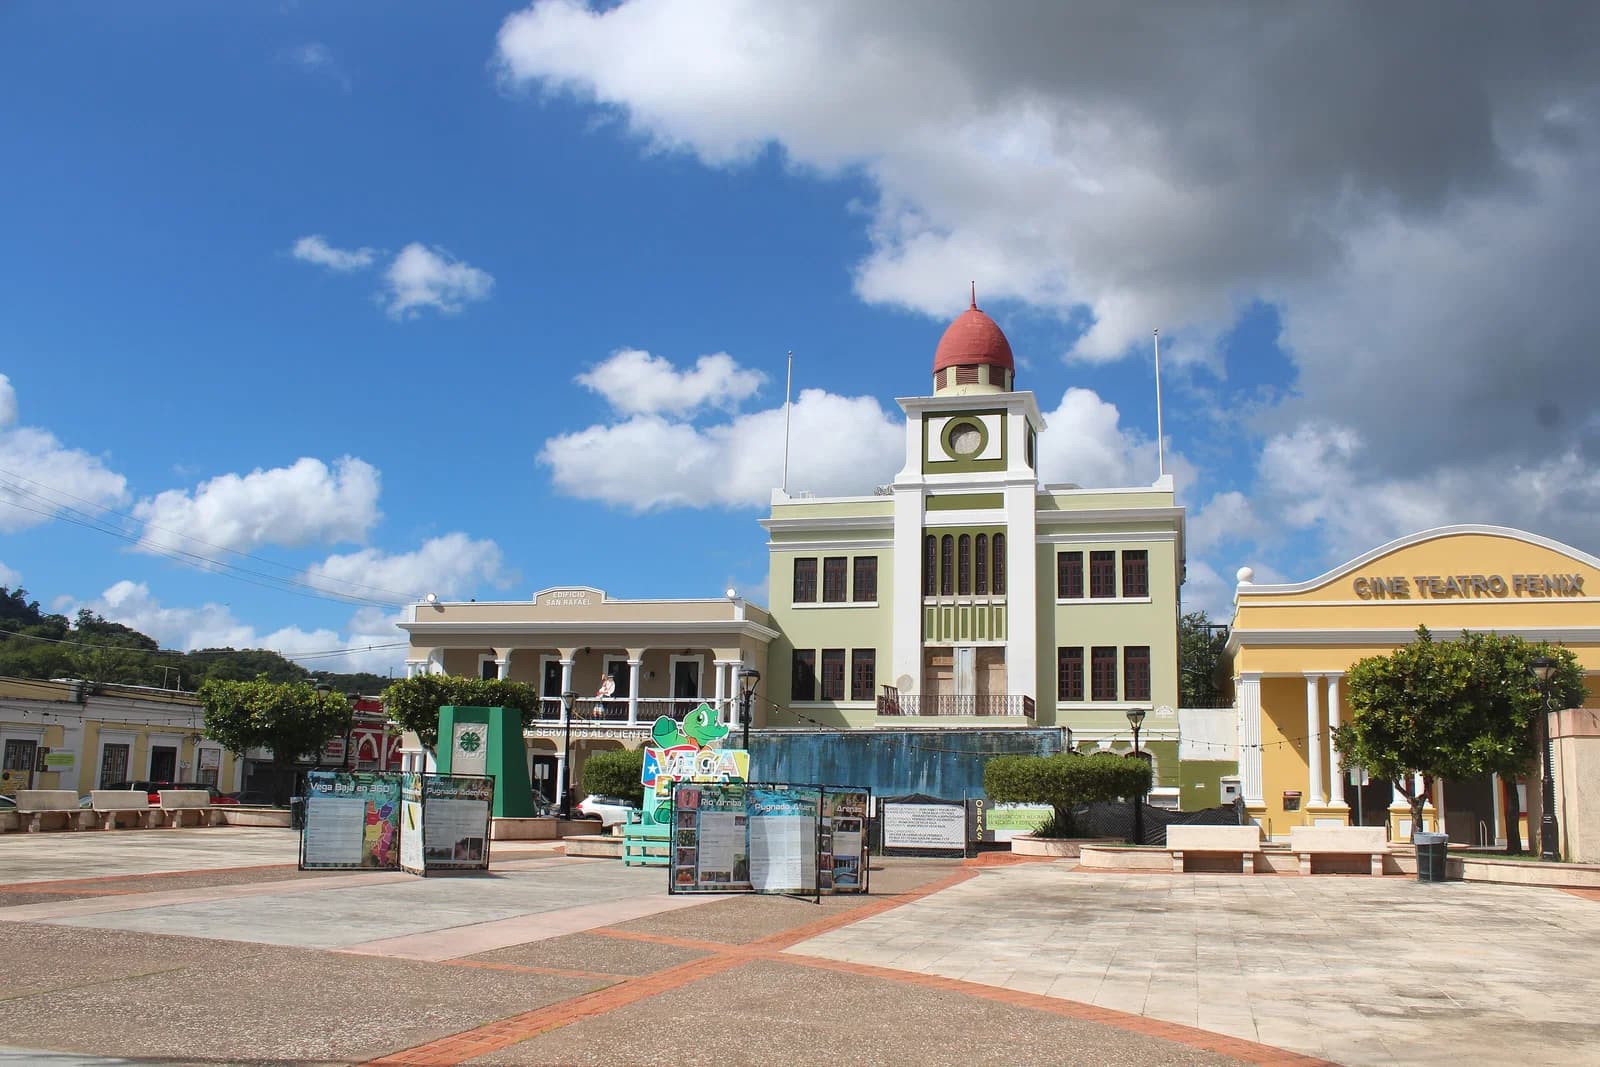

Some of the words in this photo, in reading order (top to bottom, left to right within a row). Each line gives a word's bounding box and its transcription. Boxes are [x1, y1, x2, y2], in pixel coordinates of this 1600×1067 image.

[1353, 576, 1408, 597] CINE
[1414, 574, 1505, 595] TEATRO
[1511, 573, 1582, 594] FENIX
[563, 598, 592, 606] RAFAEL
[590, 729, 602, 738] AL
[605, 729, 649, 738] CLIENTE
[654, 750, 740, 777] VEGA
[310, 782, 333, 793] Vega
[335, 783, 354, 793] Baja
[426, 787, 457, 796] Pugnado
[715, 799, 742, 807] Arriba
[755, 803, 790, 812] Pugnado
[975, 799, 984, 840] OBRAS
